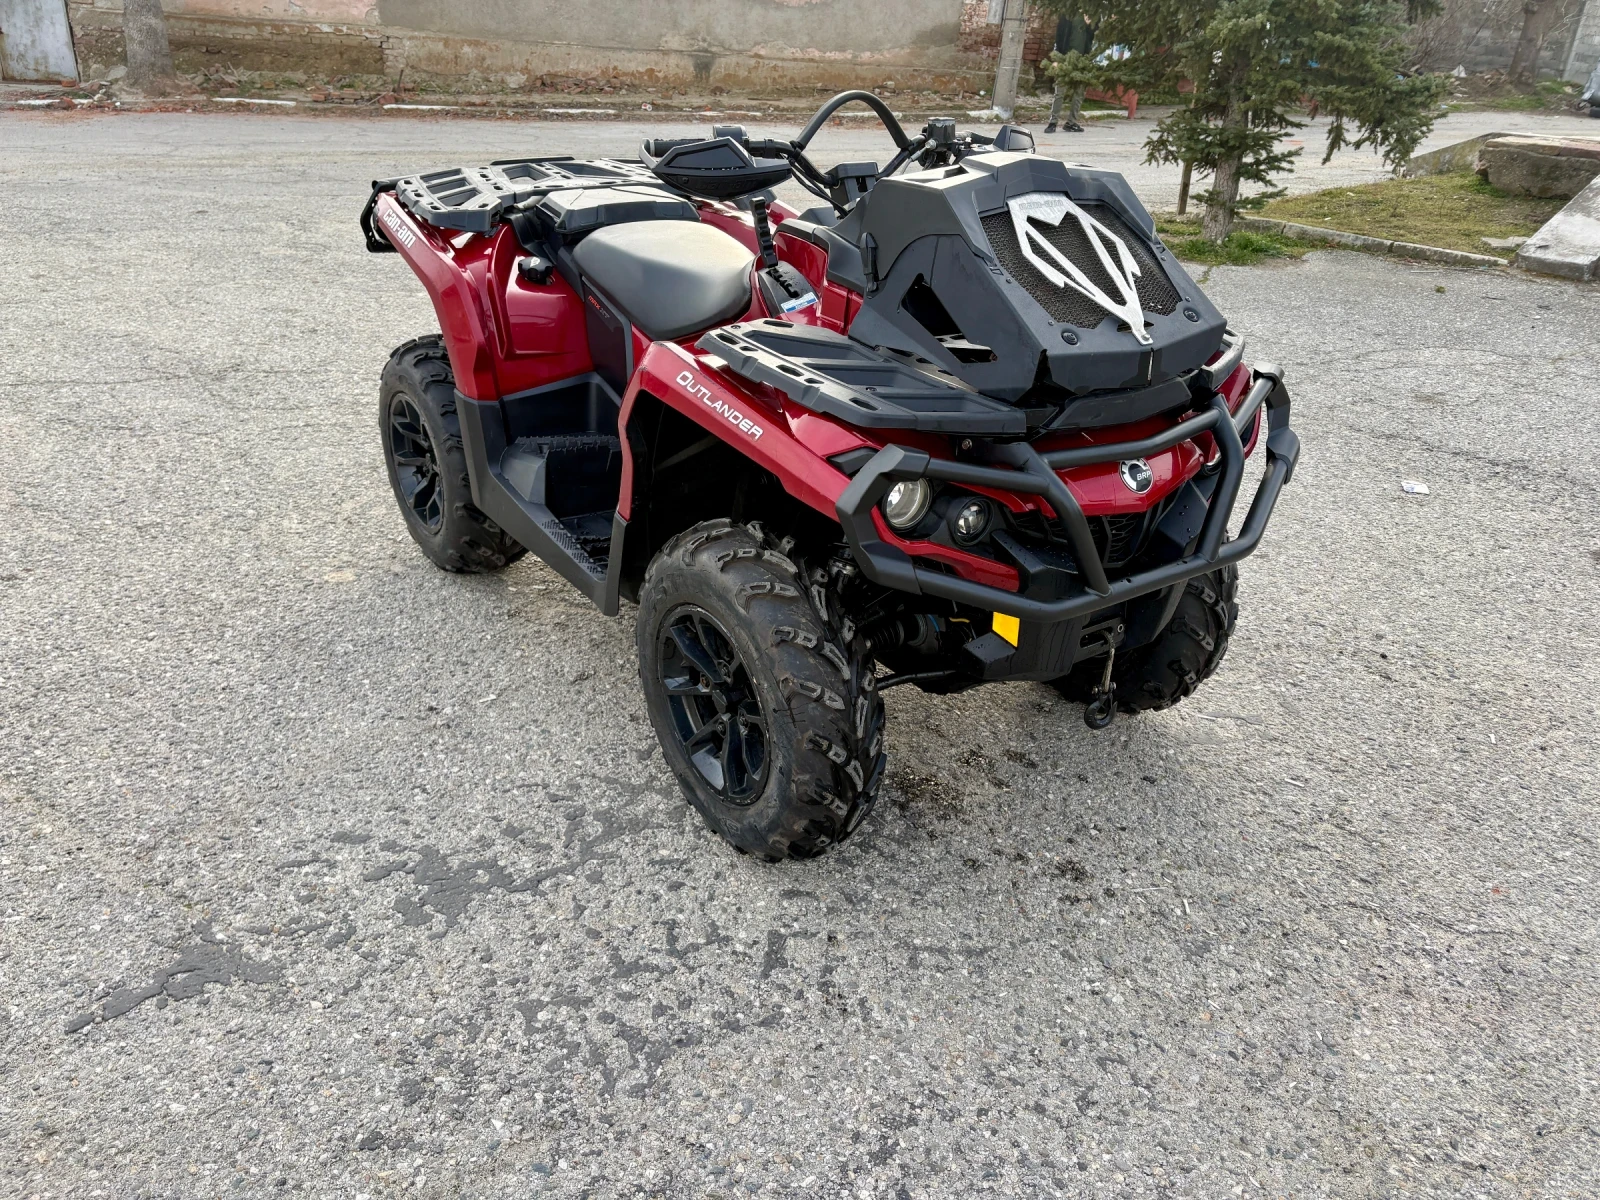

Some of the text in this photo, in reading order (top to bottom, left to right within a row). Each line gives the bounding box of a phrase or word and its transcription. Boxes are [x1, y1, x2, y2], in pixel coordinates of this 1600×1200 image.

[383, 208, 416, 248] can-am
[676, 370, 764, 440] OUTLANDER
[1136, 470, 1151, 481] BRP
